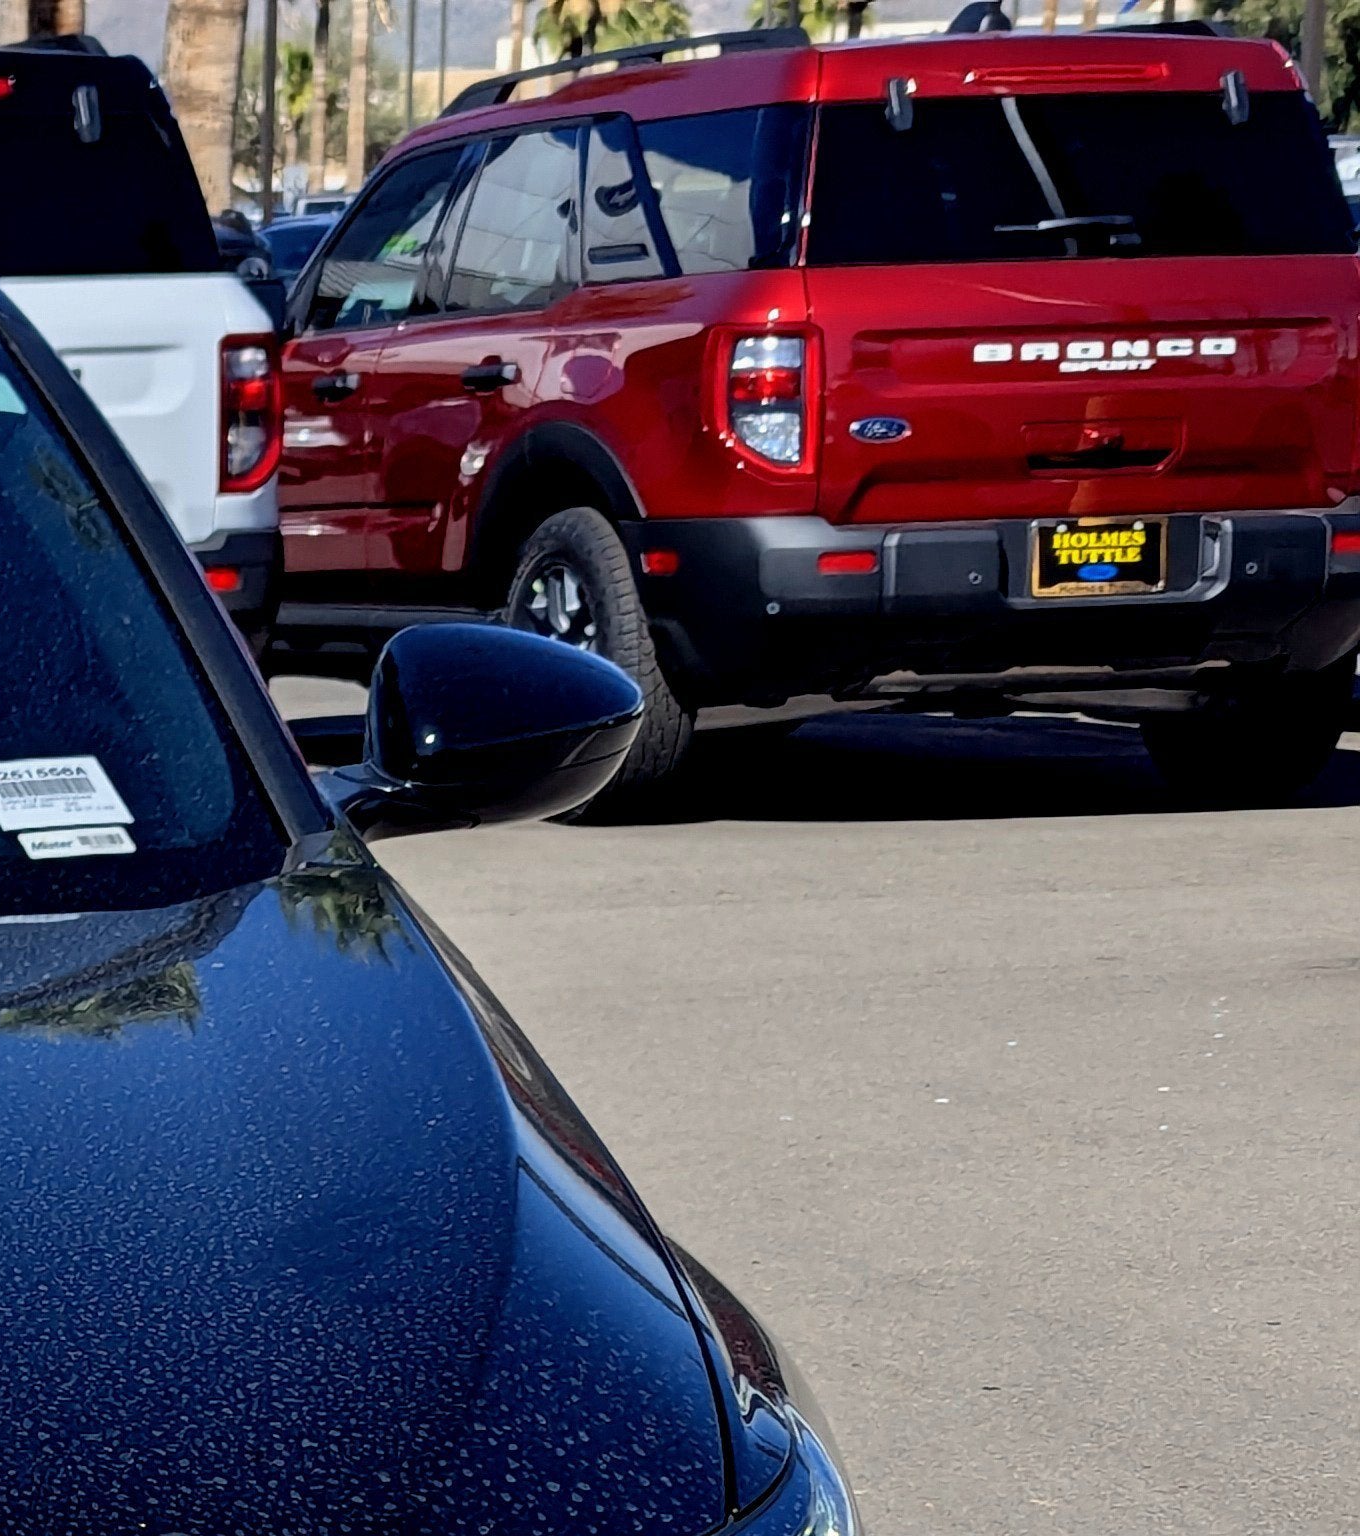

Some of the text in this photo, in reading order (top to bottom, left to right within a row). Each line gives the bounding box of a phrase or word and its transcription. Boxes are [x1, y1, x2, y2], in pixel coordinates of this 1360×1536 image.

[972, 337, 1237, 363] BRONCO
[1052, 530, 1147, 549] HOLMES
[1055, 547, 1143, 565] TUTTLE
